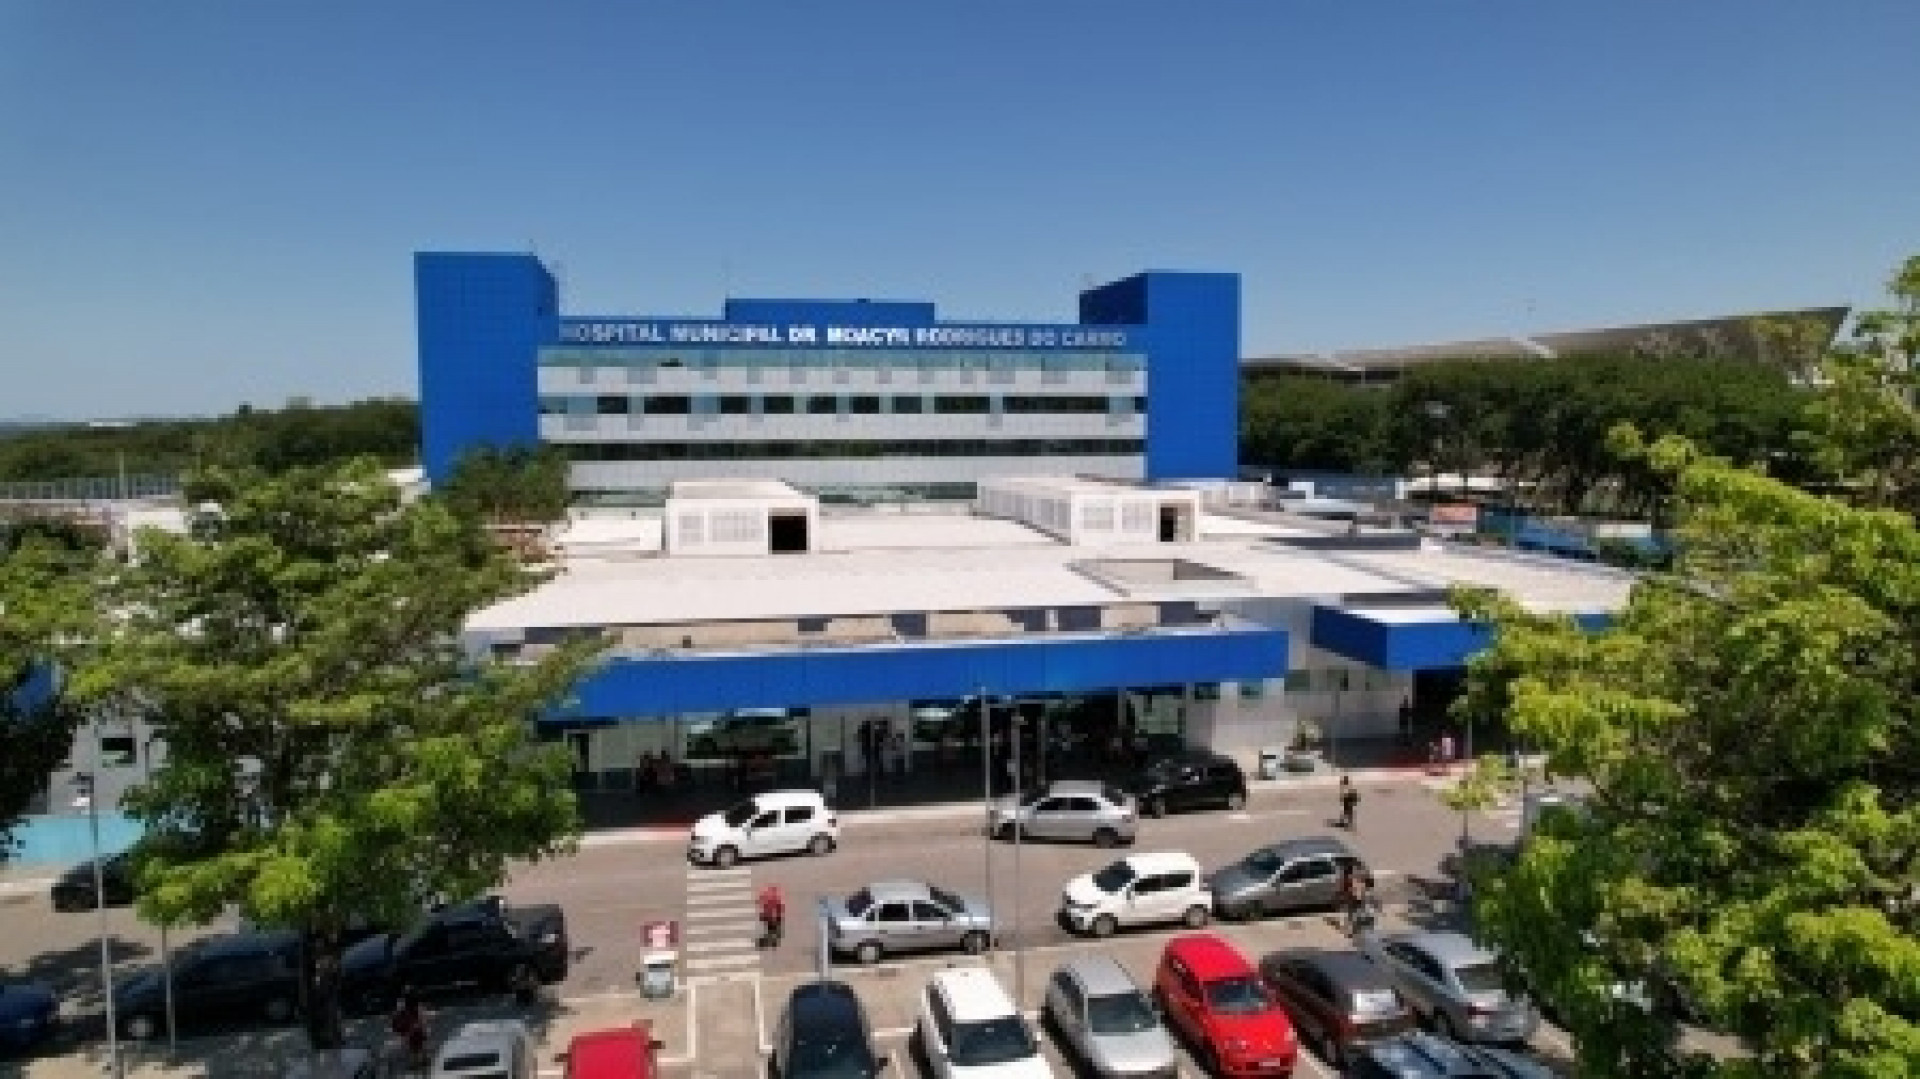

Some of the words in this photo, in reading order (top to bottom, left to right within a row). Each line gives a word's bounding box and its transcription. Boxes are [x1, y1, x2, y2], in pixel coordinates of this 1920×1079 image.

[559, 322, 664, 342] HOSPITAL
[670, 323, 783, 342] MUNICIPAL
[827, 326, 910, 345] MOACYR
[916, 327, 1024, 346] RODRIGUES
[1028, 329, 1056, 347] DO
